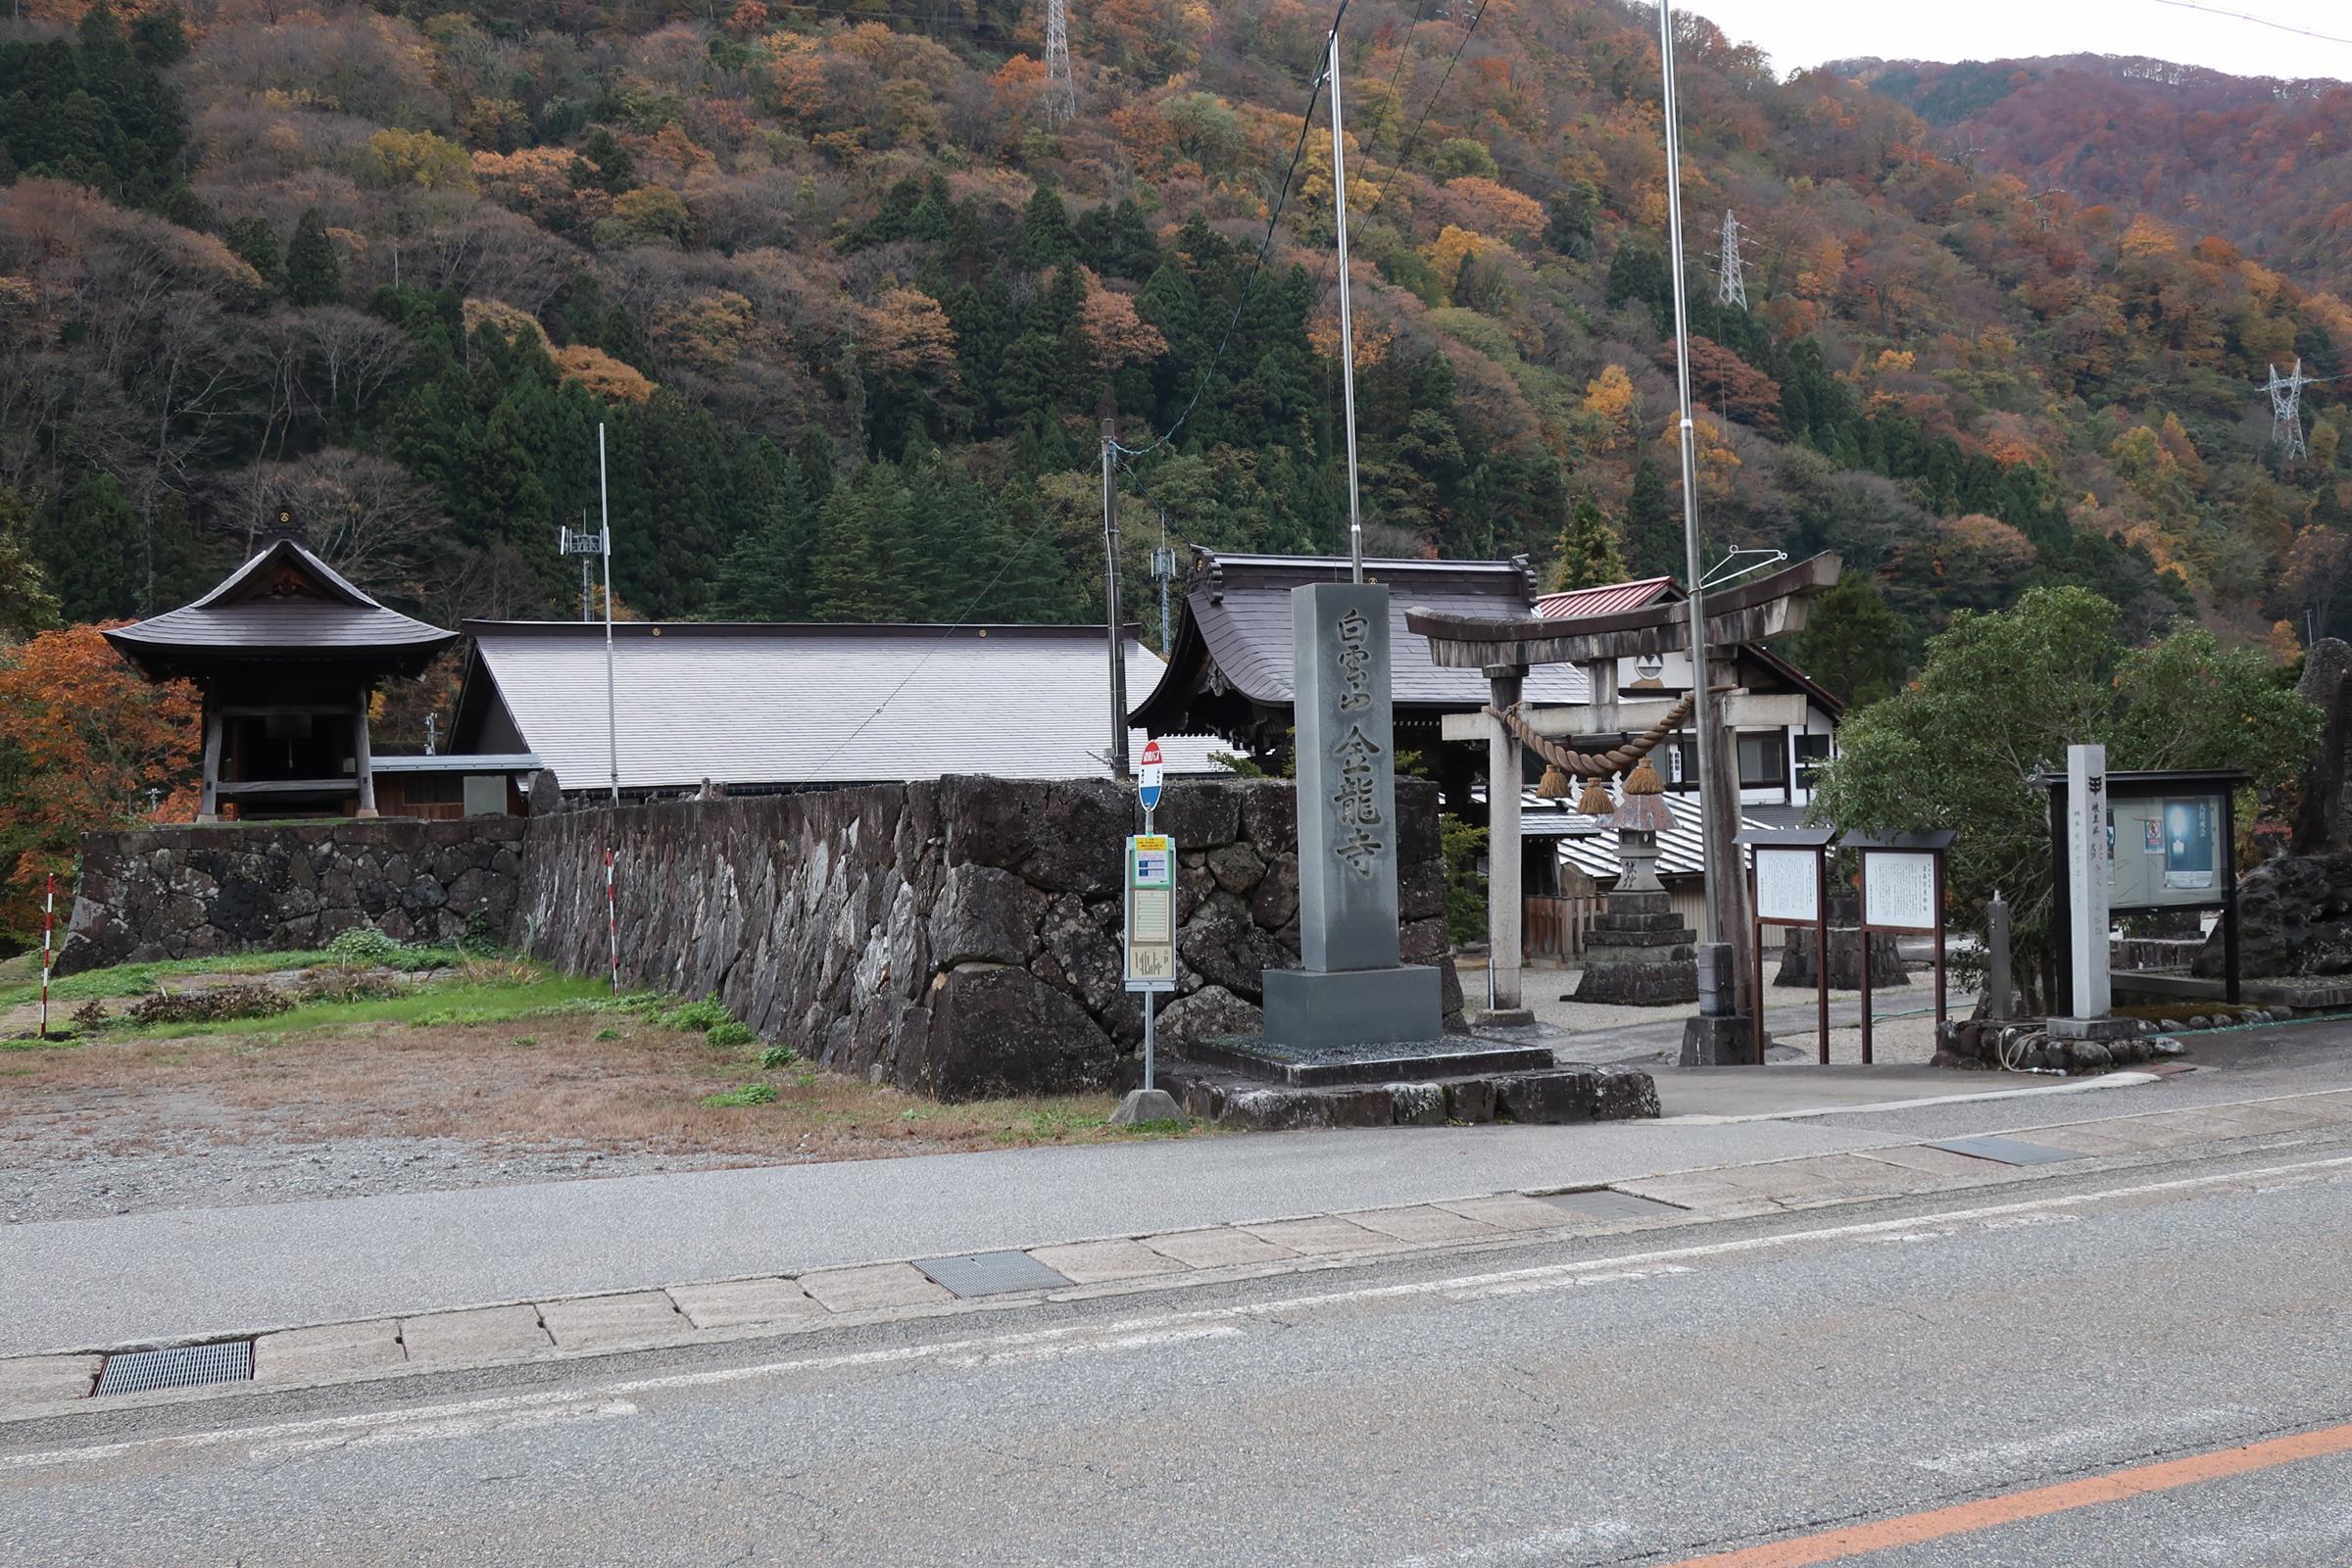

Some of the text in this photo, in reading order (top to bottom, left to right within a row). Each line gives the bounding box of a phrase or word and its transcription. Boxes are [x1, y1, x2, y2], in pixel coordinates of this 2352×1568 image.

[1334, 608, 1384, 878] 白雲山 金龍寺
